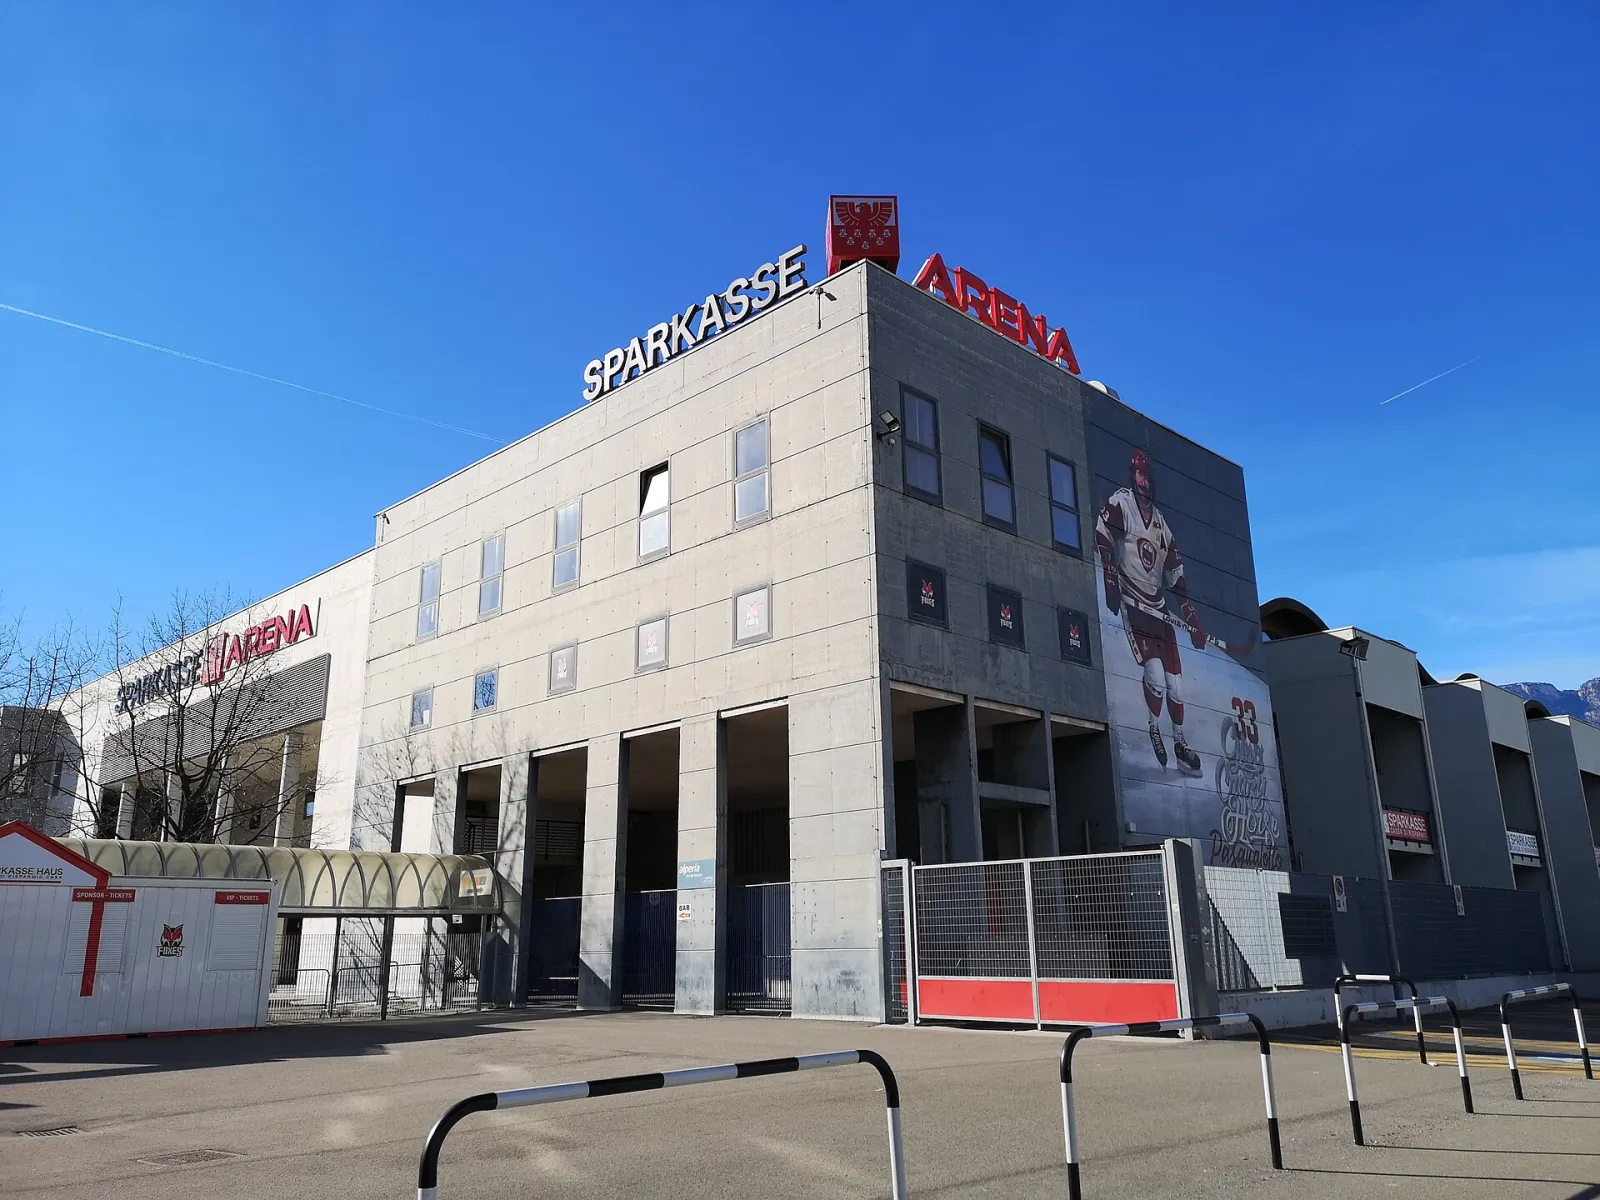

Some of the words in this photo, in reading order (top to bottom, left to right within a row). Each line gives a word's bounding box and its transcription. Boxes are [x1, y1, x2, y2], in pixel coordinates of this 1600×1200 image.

[582, 243, 808, 402] SPARKASSE
[912, 252, 1081, 375] ARENA
[225, 603, 313, 669] ARENA
[1231, 696, 1260, 745] 33
[1388, 812, 1427, 832] SPARKASSE
[0, 866, 34, 875] KASSE
[37, 867, 63, 876] HAUS
[76, 891, 104, 899] SPONSOR
[157, 945, 184, 957] FOXES
